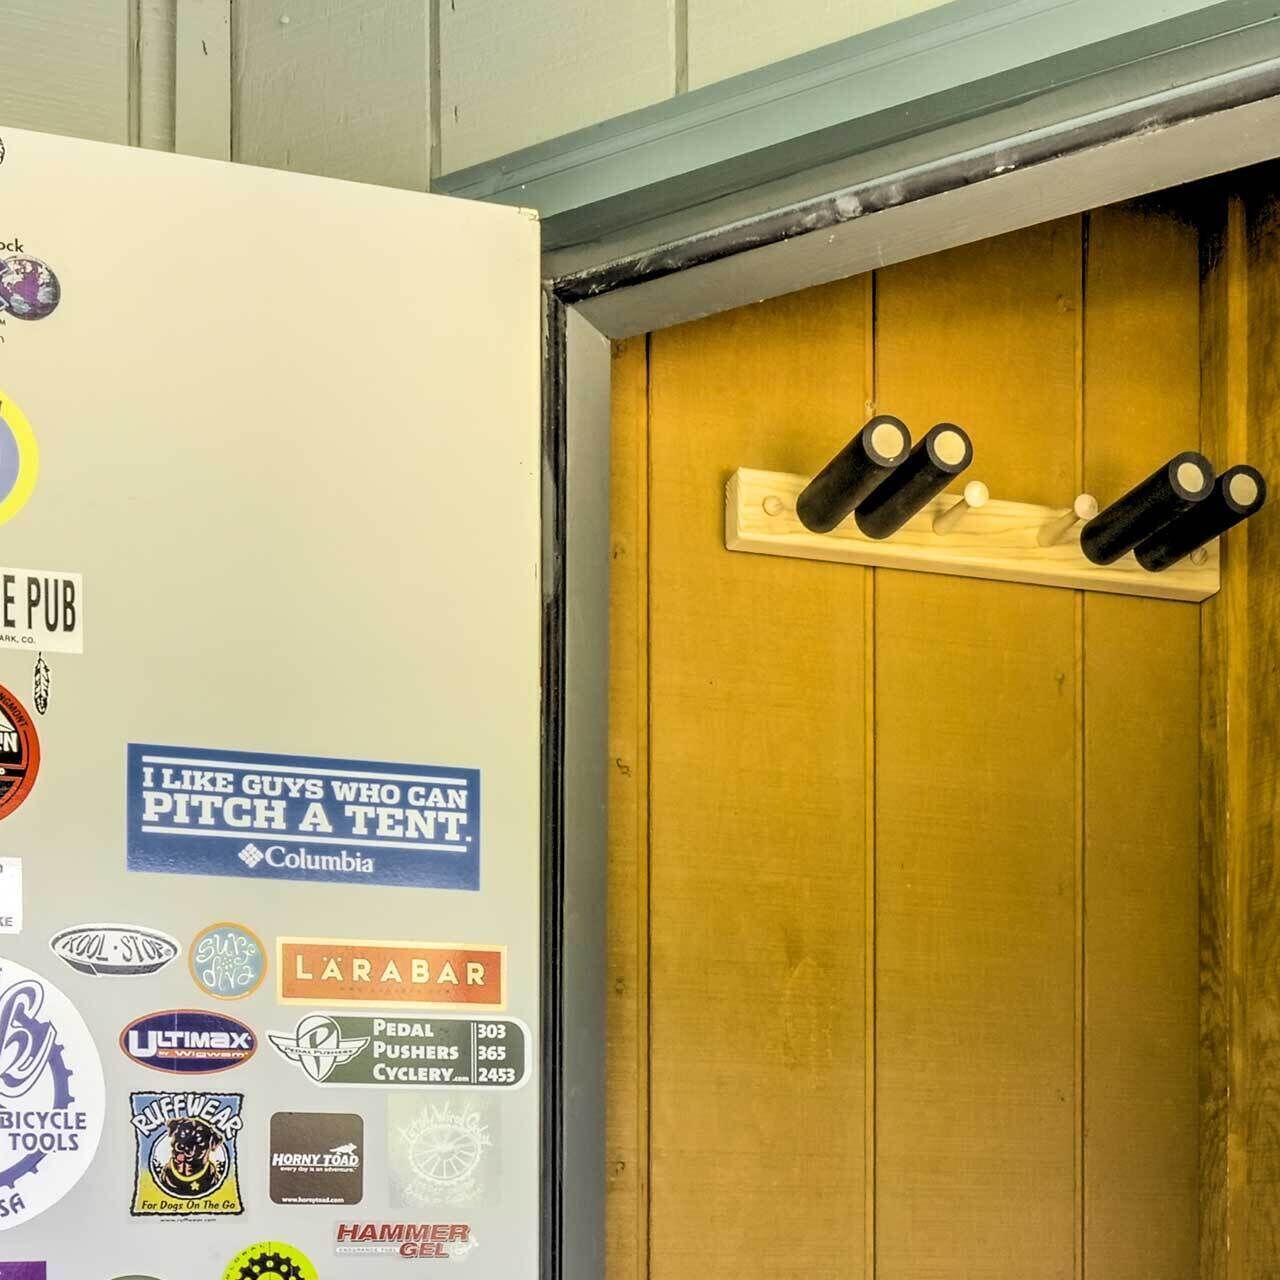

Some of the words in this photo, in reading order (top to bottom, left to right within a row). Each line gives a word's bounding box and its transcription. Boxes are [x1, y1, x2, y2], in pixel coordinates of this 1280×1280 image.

[27, 576, 76, 632] PUB
[142, 767, 154, 788] I
[162, 768, 234, 793] LIKE
[242, 774, 324, 800] GUYS
[331, 780, 401, 805] WHO
[407, 785, 468, 810] CAN
[142, 791, 287, 830] PITCH
[298, 802, 333, 833] A
[344, 804, 472, 842] TENT.
[264, 846, 374, 873] Columbia
[62, 934, 108, 962] KOOL
[121, 935, 164, 962] STOP
[373, 1018, 434, 1038] PEDAL
[478, 1023, 506, 1039] 303
[373, 1041, 459, 1060] PUSHERS
[478, 1045, 506, 1060] 365
[478, 1067, 516, 1083] 2453
[130, 1093, 243, 1140] RUFFWEAR
[8, 1133, 79, 1151] TOOLS
[272, 1153, 320, 1166] HORNY
[324, 1154, 359, 1167] TOAD
[142, 1200, 157, 1210] For
[160, 1200, 183, 1211] Dogs
[222, 1200, 235, 1210] Go
[337, 1224, 471, 1242] HAMMER
[399, 1243, 449, 1258] GEL
